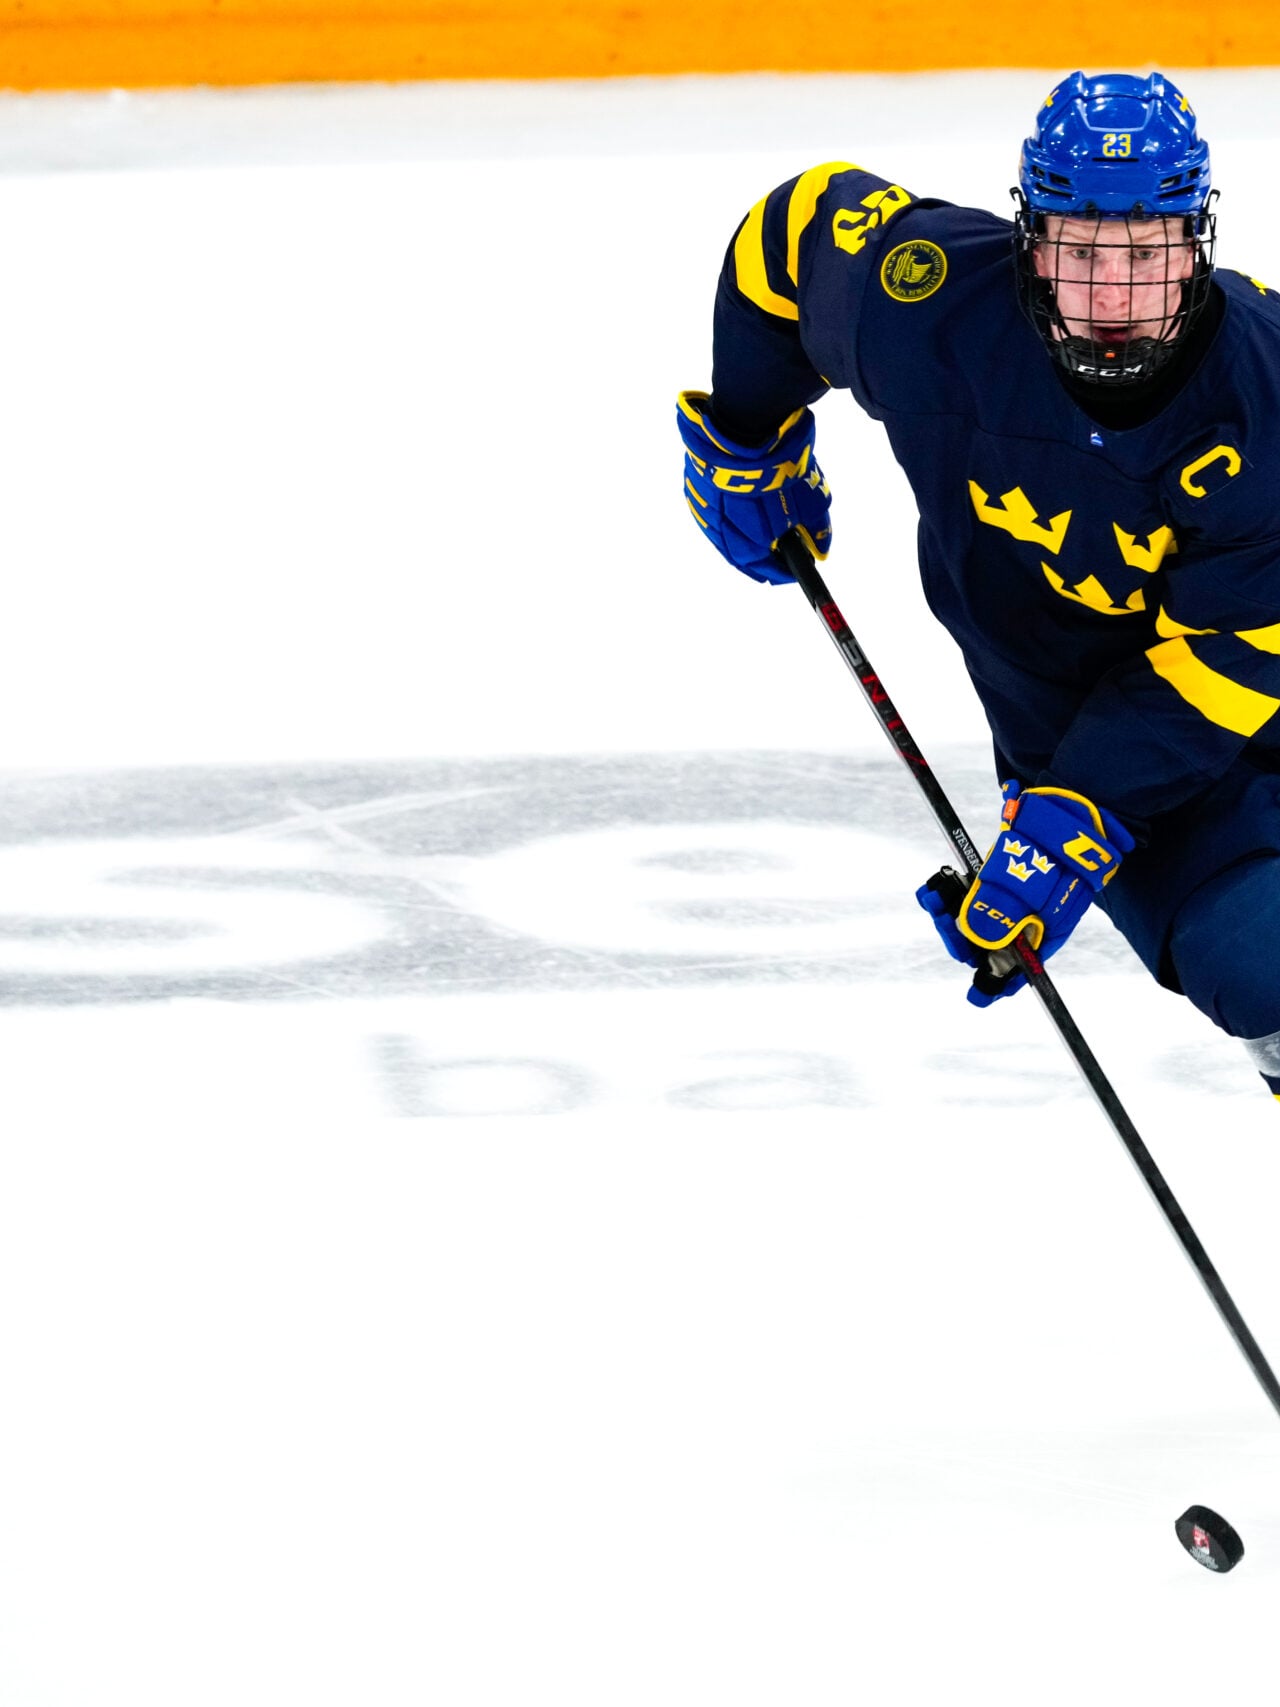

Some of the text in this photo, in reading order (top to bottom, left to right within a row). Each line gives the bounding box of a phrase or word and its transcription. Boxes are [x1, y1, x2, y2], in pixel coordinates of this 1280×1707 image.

[1102, 133, 1131, 157] 23
[1077, 363, 1143, 377] CCM
[686, 443, 811, 493] CCM
[1180, 444, 1242, 498] C
[952, 828, 982, 872] STENBERG
[973, 901, 1017, 929] CCM
